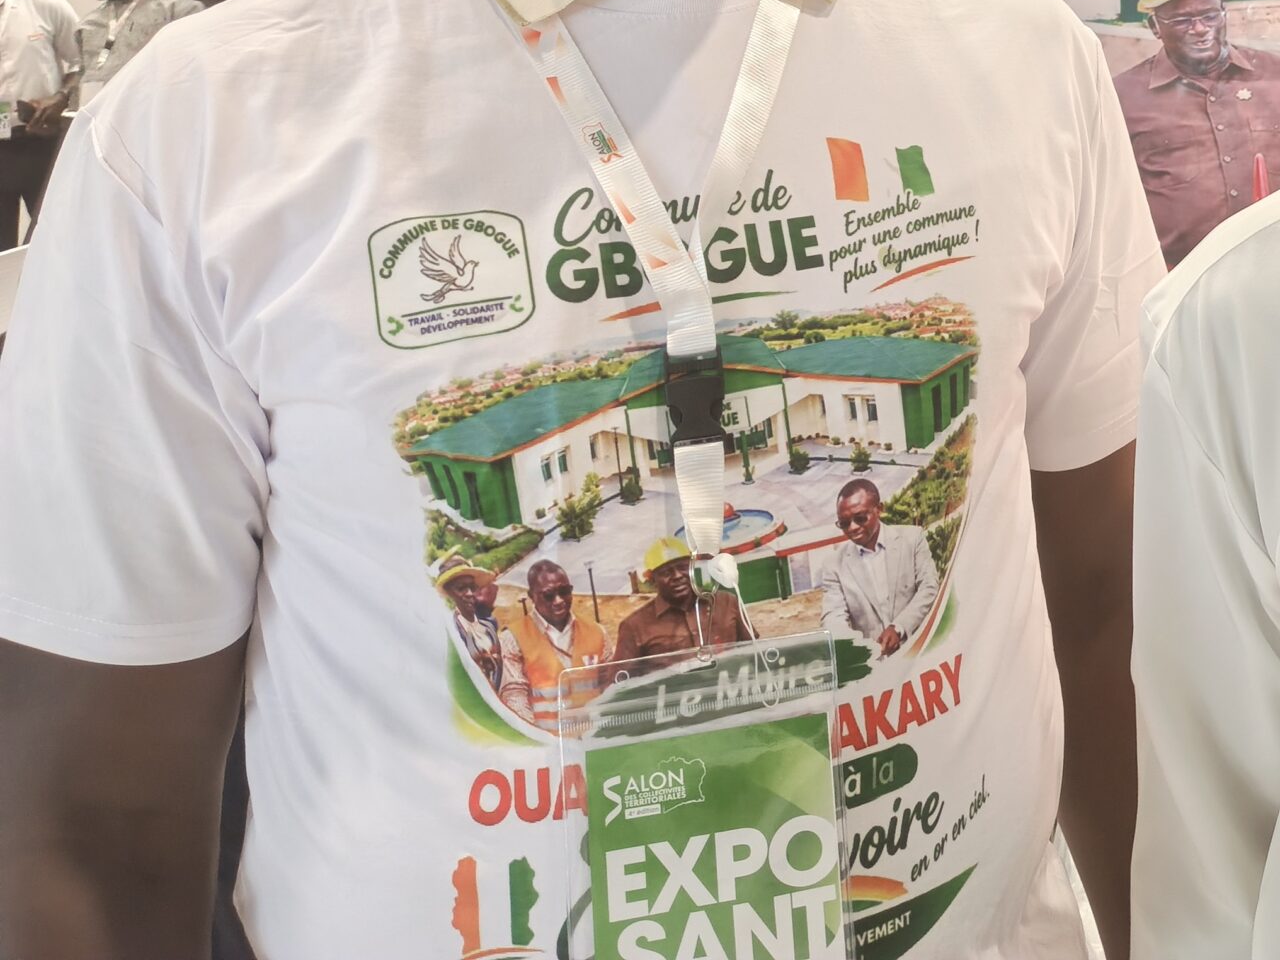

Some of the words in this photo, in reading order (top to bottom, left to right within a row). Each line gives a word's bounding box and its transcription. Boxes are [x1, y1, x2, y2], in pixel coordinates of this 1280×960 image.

[751, 168, 792, 214] de
[843, 191, 922, 237] Ensemble
[379, 219, 439, 279] COMMUNE
[441, 218, 460, 230] DE
[463, 218, 521, 259] GBOGUE
[545, 215, 825, 304] GBGUE
[829, 237, 867, 272] pour
[872, 226, 903, 246] une
[905, 204, 976, 234] commune
[843, 257, 878, 294] plus
[882, 232, 970, 273] dynamique
[408, 313, 444, 327] TRAVAIL
[654, 685, 702, 725] Le
[715, 656, 827, 711] Maire
[603, 767, 685, 827] SALON
[624, 792, 687, 808] TERRITORIALES
[844, 765, 862, 798] à
[872, 756, 895, 789] la
[605, 814, 838, 923] EXPO
[910, 855, 931, 882] en
[951, 814, 968, 841] en
